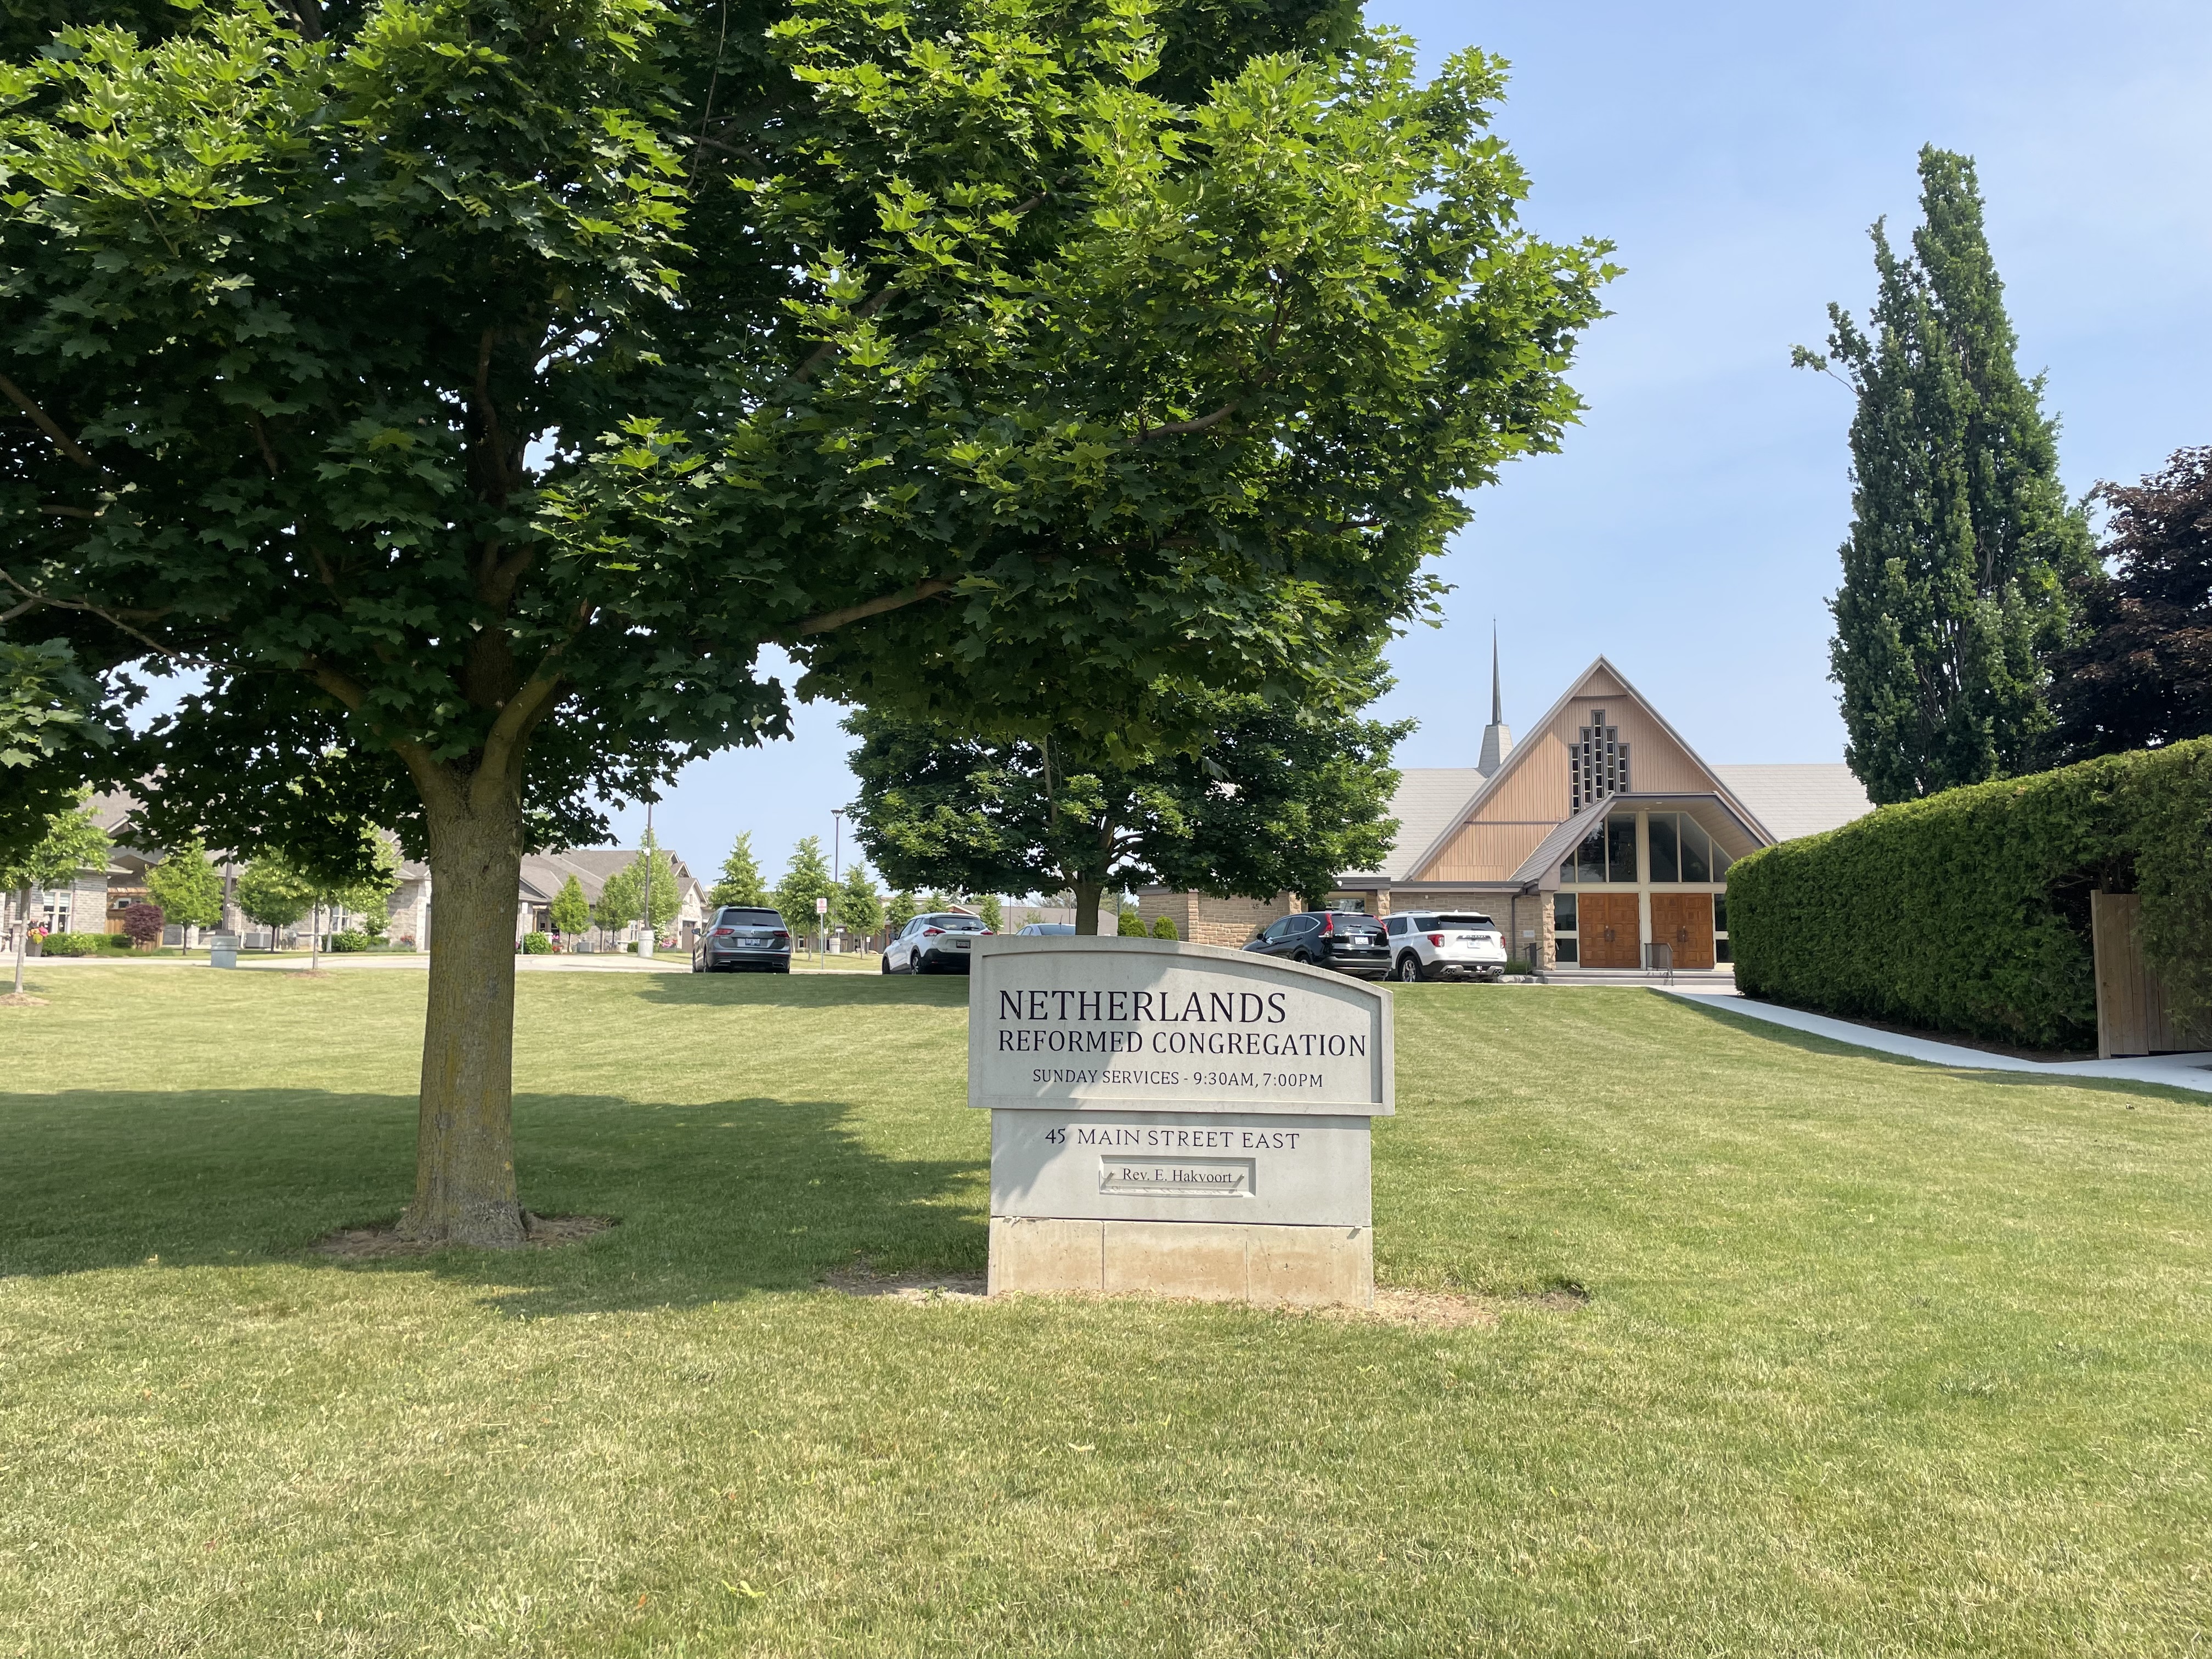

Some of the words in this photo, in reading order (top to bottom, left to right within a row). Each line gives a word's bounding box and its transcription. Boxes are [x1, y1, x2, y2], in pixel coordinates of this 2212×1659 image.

[998, 990, 1286, 1024] NETHERLANDS
[998, 1030, 1143, 1053] REFORMED
[1152, 1031, 1366, 1057] CONGREGATION
[1033, 1069, 1098, 1083] SUNDAY
[1102, 1070, 1179, 1085] SERVICES
[1193, 1071, 1259, 1088] 9:30AM,
[1263, 1073, 1323, 1088] 7:00PM
[1045, 1128, 1066, 1144] 45
[1077, 1128, 1141, 1146] MAIN
[1148, 1130, 1234, 1148] STREET
[1242, 1132, 1300, 1149] EAST
[1123, 1168, 1150, 1181] Rev.
[1155, 1169, 1167, 1181] E.
[1173, 1170, 1232, 1183] Hakvoort
